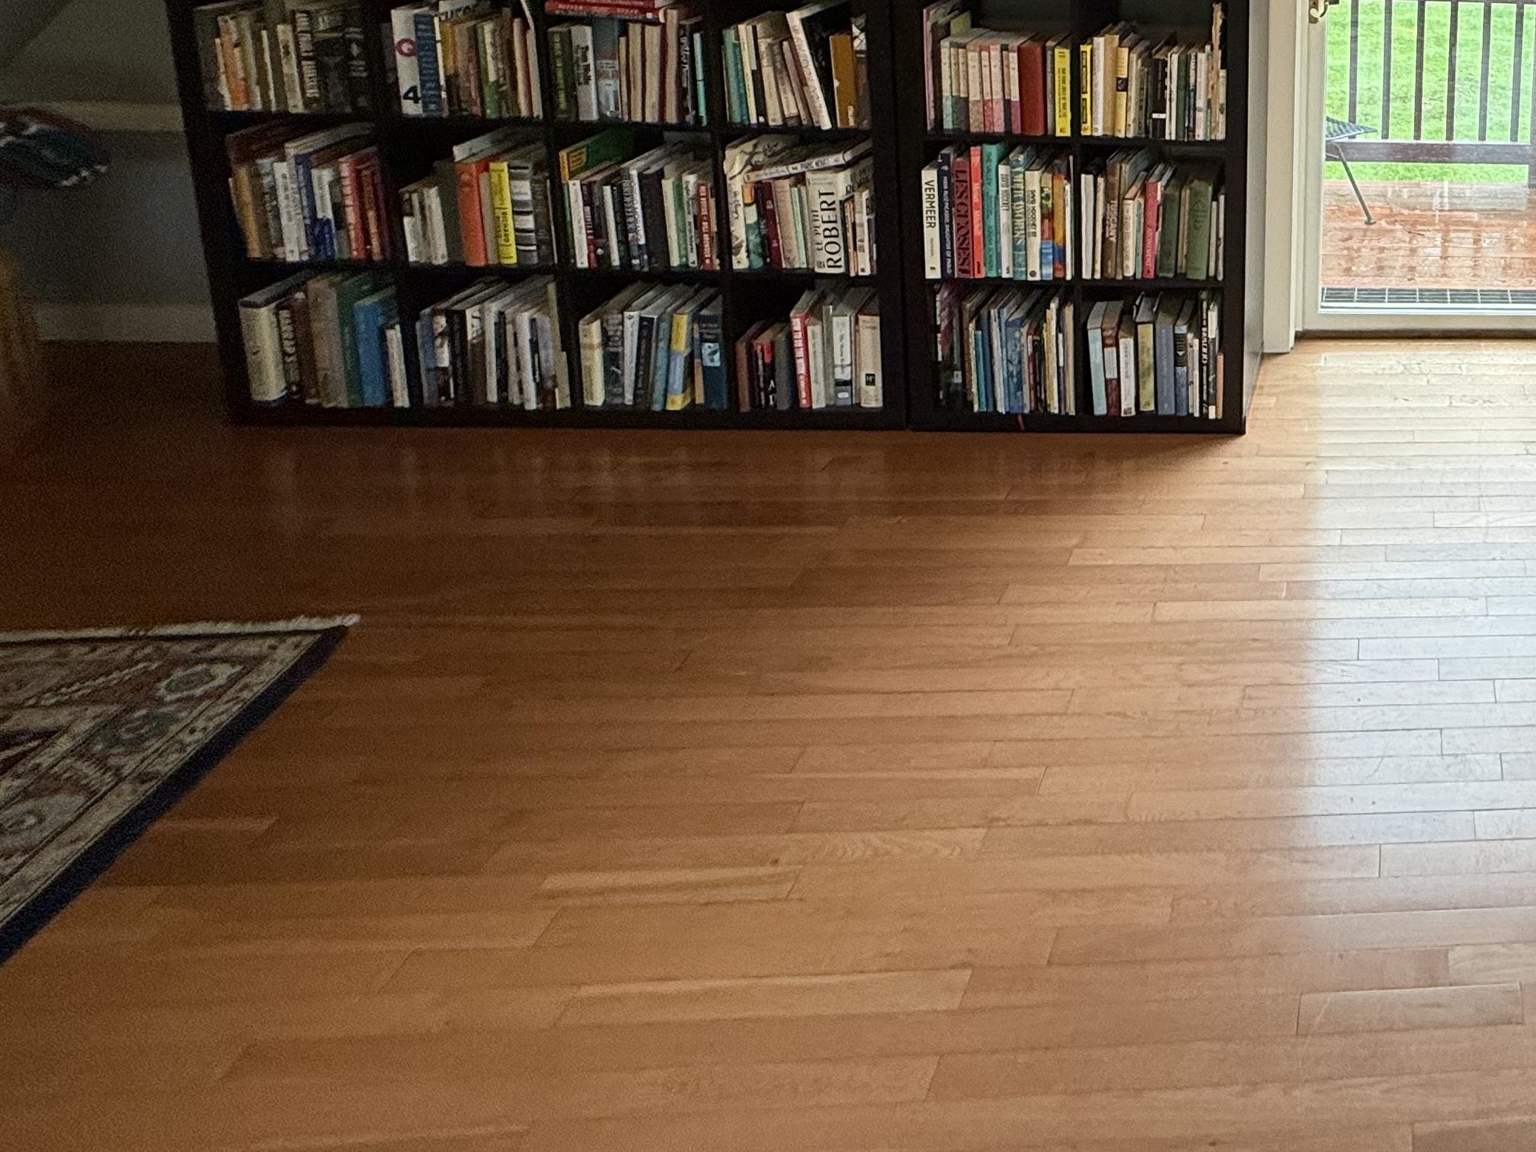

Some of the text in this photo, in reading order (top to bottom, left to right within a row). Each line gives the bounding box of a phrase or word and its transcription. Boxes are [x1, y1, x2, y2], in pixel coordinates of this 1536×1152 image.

[924, 179, 936, 229] VERMEER
[1110, 200, 1118, 241] TUSCANY
[811, 209, 823, 252] LE PETIT
[819, 190, 842, 269] ROBERT
